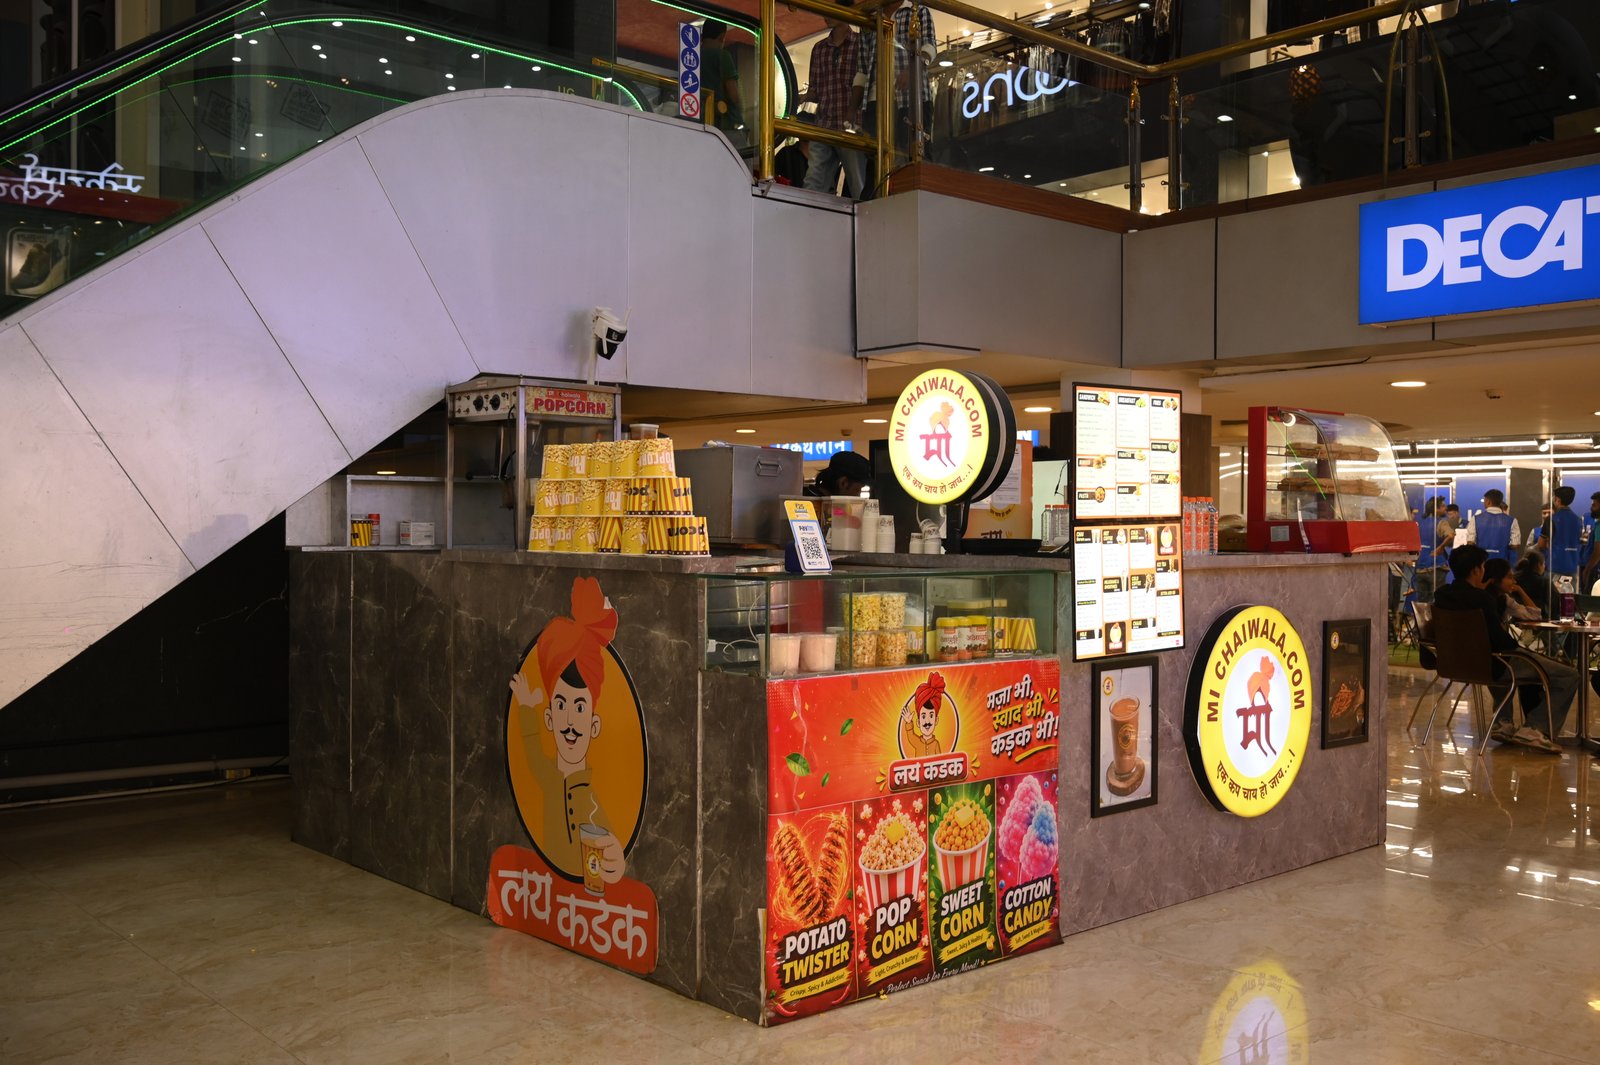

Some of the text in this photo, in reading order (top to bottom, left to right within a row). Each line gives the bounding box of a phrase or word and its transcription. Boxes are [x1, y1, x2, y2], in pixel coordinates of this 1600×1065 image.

[534, 398, 606, 414] POPCORN
[895, 376, 982, 442] MI CHAIWALA.COM
[924, 484, 938, 495] चाय
[939, 482, 947, 495] हो
[1207, 617, 1305, 722] MI CHAIWALA.COM
[993, 704, 1024, 731] स्वाद
[1037, 711, 1059, 741] भी!
[1217, 760, 1229, 784] एक
[1228, 782, 1240, 797] कप
[1242, 787, 1258, 800] चाय
[1259, 781, 1268, 799] हो
[941, 881, 984, 916] SWEET
[1005, 877, 1052, 910] COTTON
[498, 867, 648, 961] लय कडक
[876, 897, 911, 933] POP
[940, 901, 985, 942] CORN
[1004, 896, 1053, 934] CANDY
[785, 918, 847, 960] POTATO
[871, 918, 917, 959] CORN
[782, 941, 850, 984] TWISTER
[808, 984, 820, 992] Spicy
